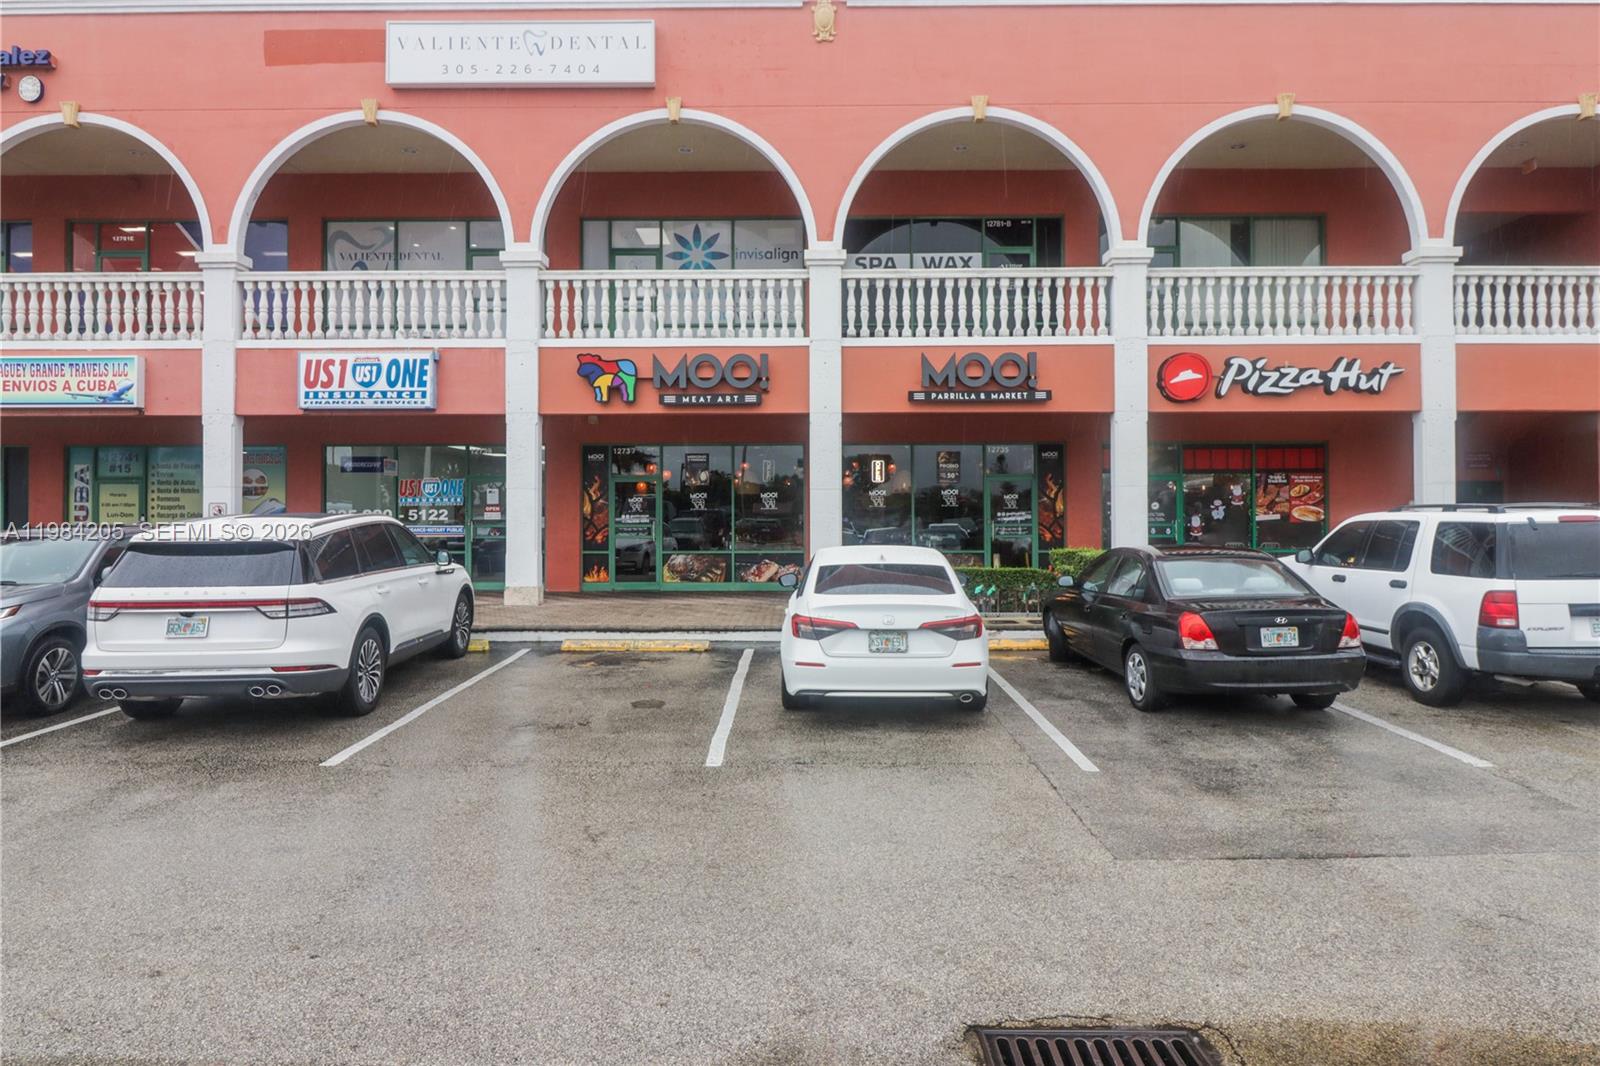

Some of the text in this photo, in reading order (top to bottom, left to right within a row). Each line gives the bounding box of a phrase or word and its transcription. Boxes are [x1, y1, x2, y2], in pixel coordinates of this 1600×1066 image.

[397, 35, 647, 50] VALIENTE DENTAL
[441, 64, 601, 75] 305-226-7404
[339, 251, 444, 261] VALIENTE DENTAL
[735, 248, 799, 263] invisalign
[921, 256, 973, 268] WAX
[30, 363, 66, 377] GRANDE
[69, 362, 109, 377] TRAVELS
[112, 363, 129, 377] LLC
[386, 358, 429, 389] ONE
[652, 353, 769, 389] MOO!
[921, 351, 1038, 388] MOO!
[1220, 356, 1405, 395] Pizza Hut
[2, 380, 117, 392] ENVIOS A CUBA
[307, 391, 426, 399] INSURANCE
[682, 395, 711, 403] MEAT
[931, 392, 976, 400] PARRILLA
[441, 480, 464, 496] ONE
[408, 509, 449, 521] 5122
